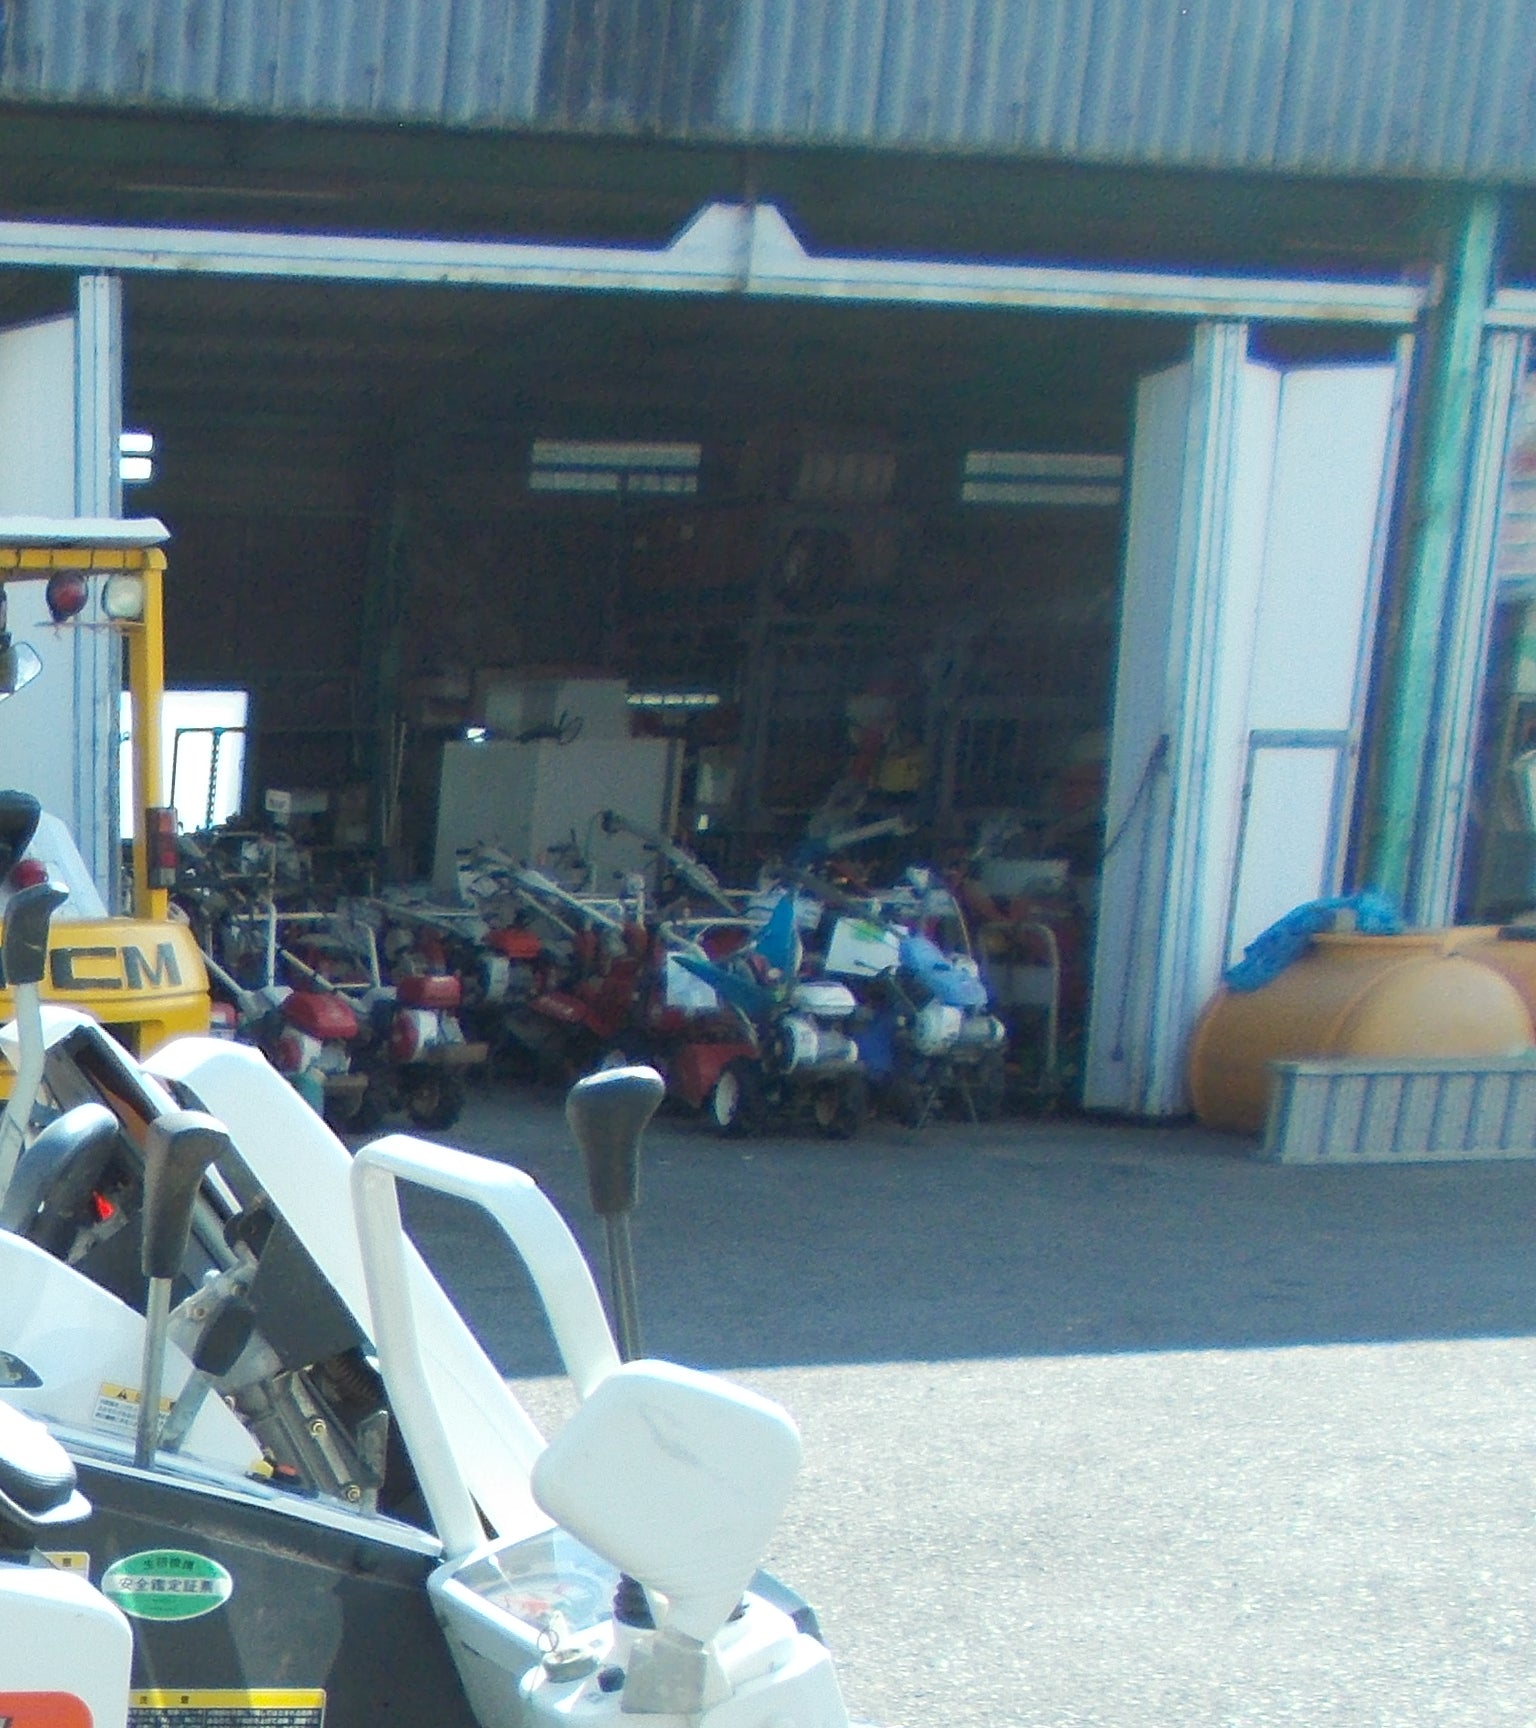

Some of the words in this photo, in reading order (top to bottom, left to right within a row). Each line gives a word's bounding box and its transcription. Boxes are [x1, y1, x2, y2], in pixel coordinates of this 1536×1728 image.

[119, 1577, 215, 1593] 安全鑑定証票
